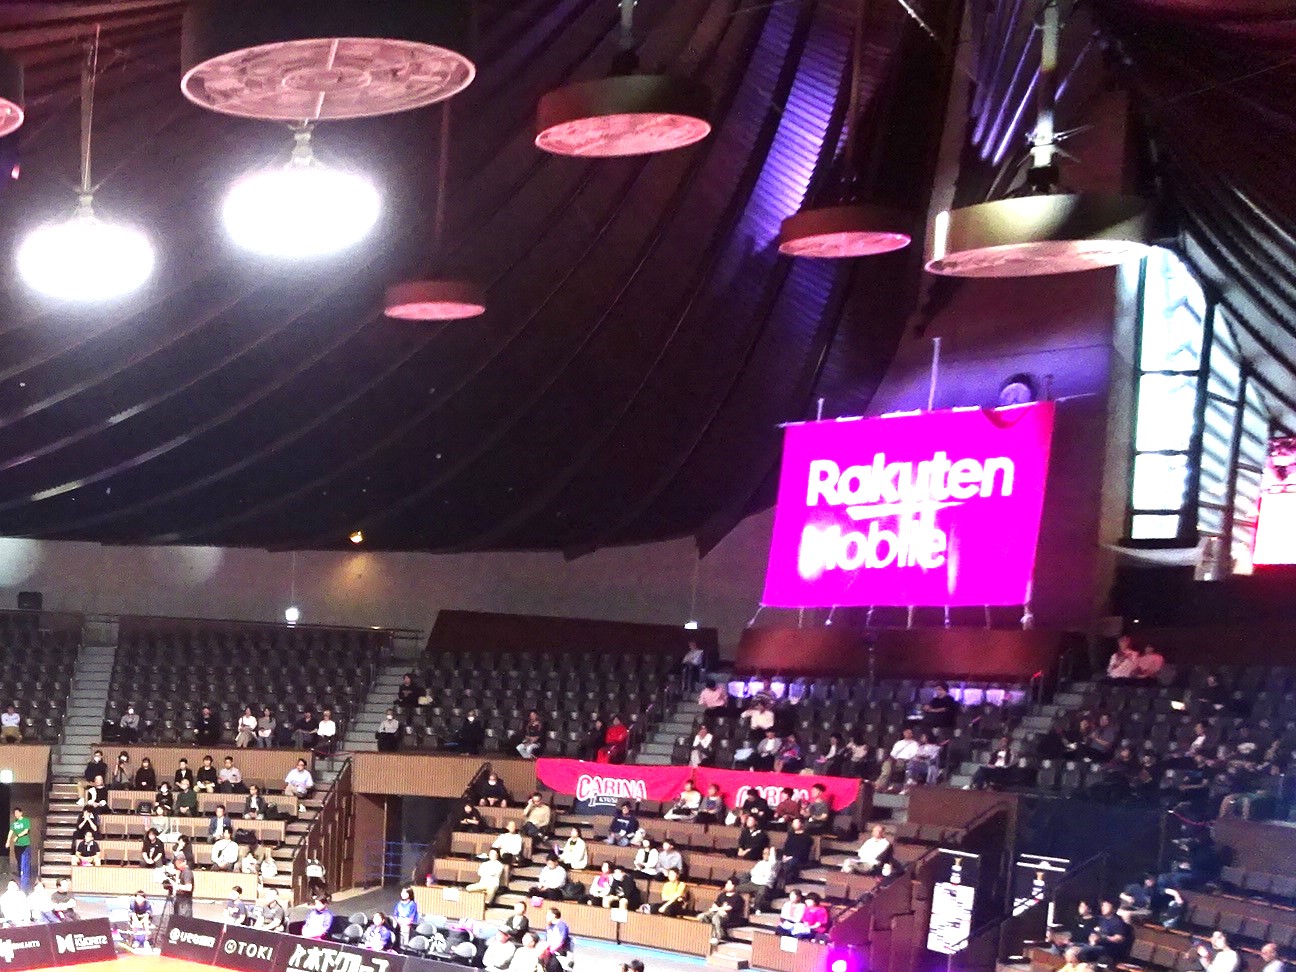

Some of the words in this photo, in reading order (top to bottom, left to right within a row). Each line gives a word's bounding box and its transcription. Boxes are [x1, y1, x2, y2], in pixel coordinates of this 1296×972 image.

[806, 451, 1015, 506] Rakuten
[799, 521, 947, 573] Mobile
[576, 775, 647, 802] CARINA
[238, 941, 274, 961] TOKI
